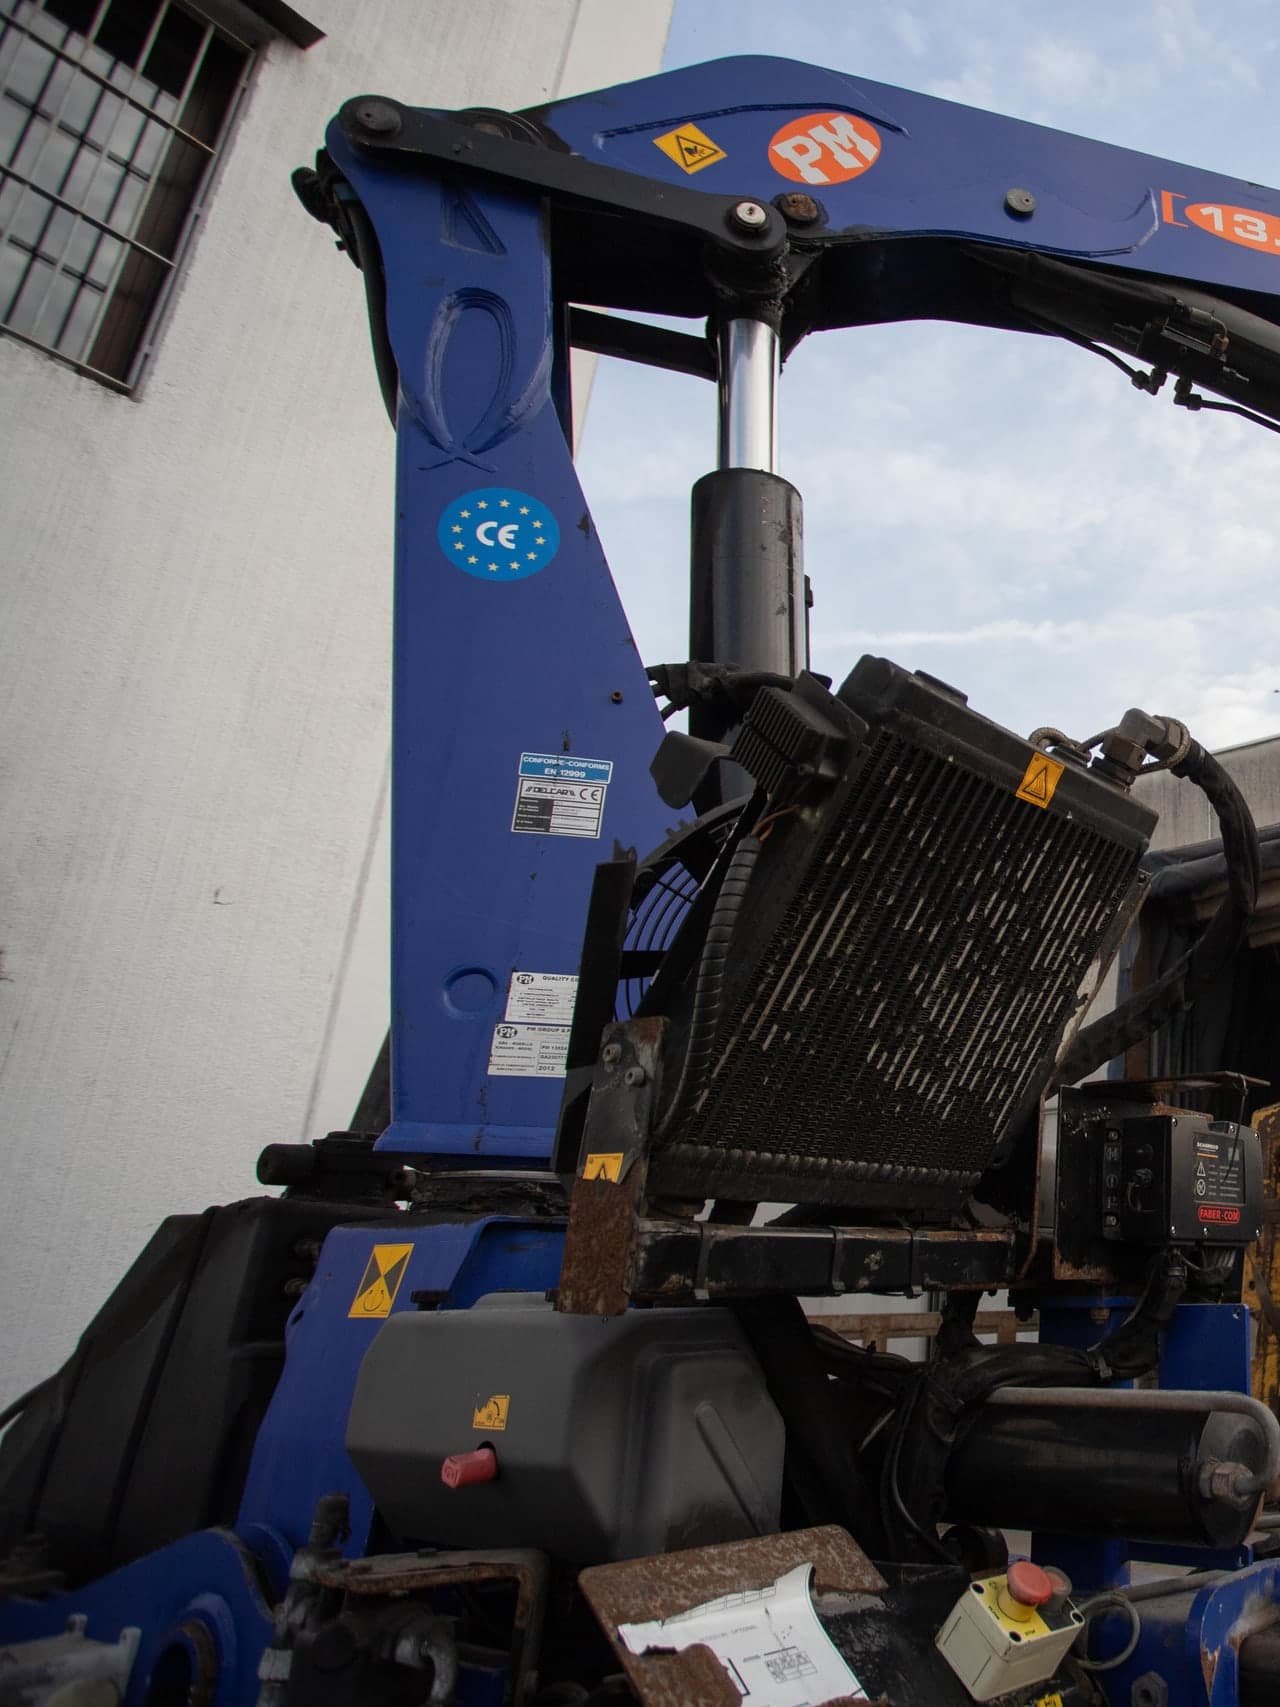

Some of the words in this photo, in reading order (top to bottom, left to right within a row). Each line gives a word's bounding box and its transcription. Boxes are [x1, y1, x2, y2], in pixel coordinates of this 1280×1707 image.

[772, 115, 879, 185] PM
[475, 520, 520, 550] CE
[544, 767, 557, 776] EN
